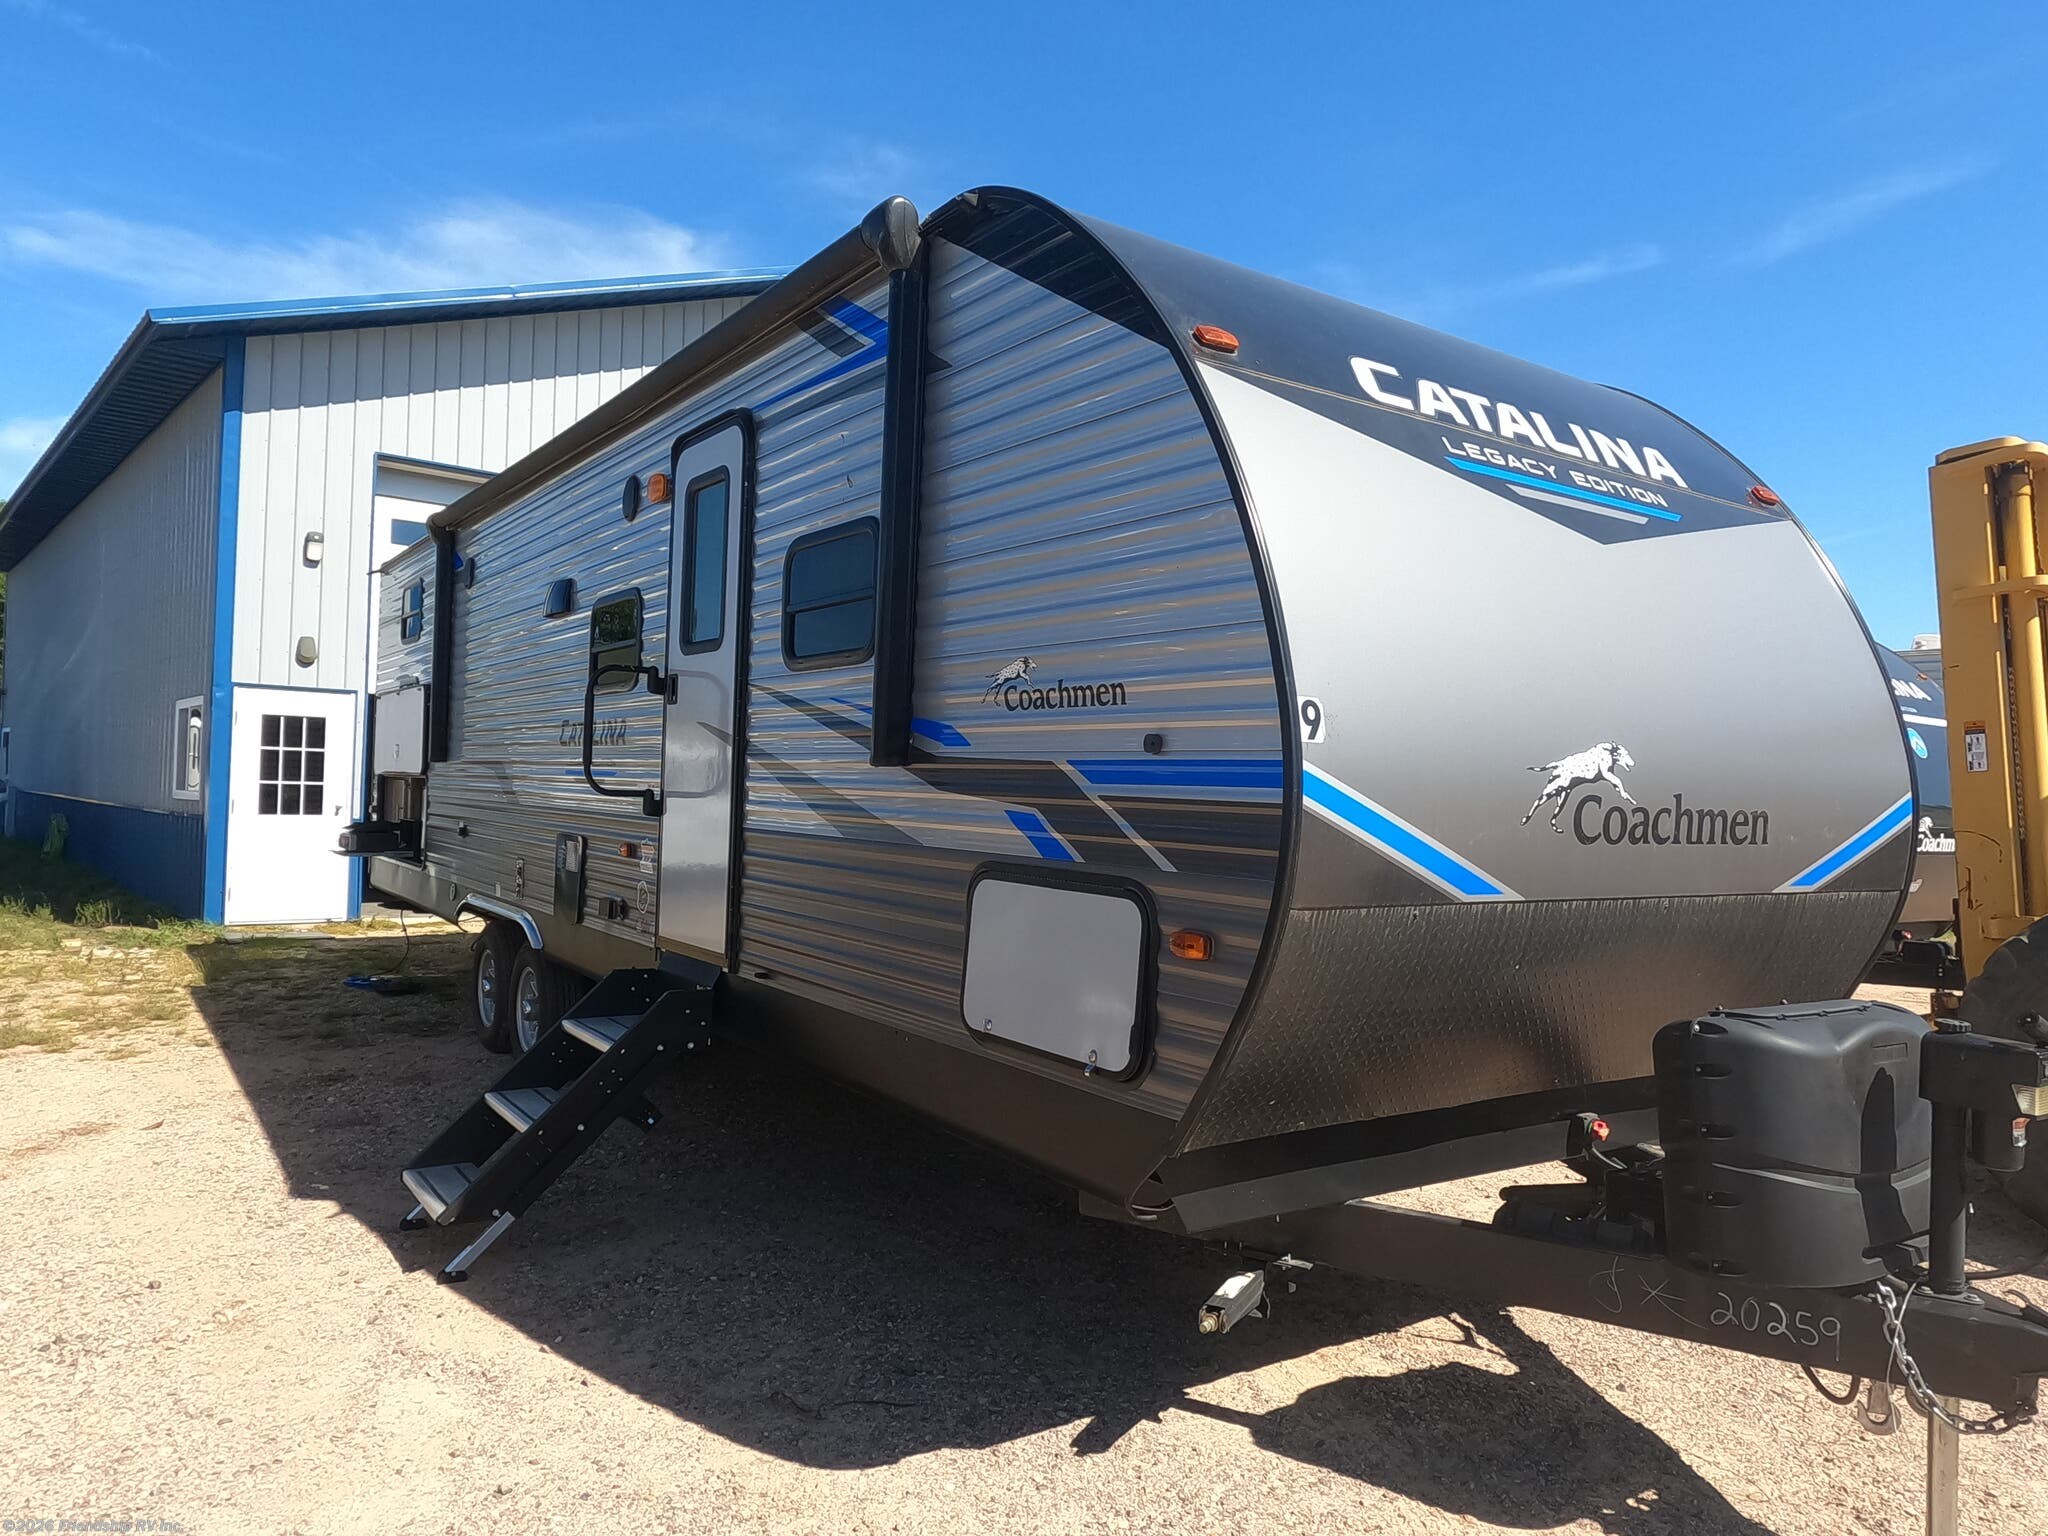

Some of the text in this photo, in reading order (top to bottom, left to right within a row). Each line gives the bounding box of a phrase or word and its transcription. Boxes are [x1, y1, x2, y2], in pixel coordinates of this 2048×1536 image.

[1349, 355, 1689, 488] CATALINA
[1441, 436, 1669, 508] LEGACY EDITION
[1004, 679, 1127, 712] Coachmen
[1301, 699, 1321, 740] 9
[1573, 793, 1769, 846] Coachmen
[1710, 1291, 1841, 1362] 20259
